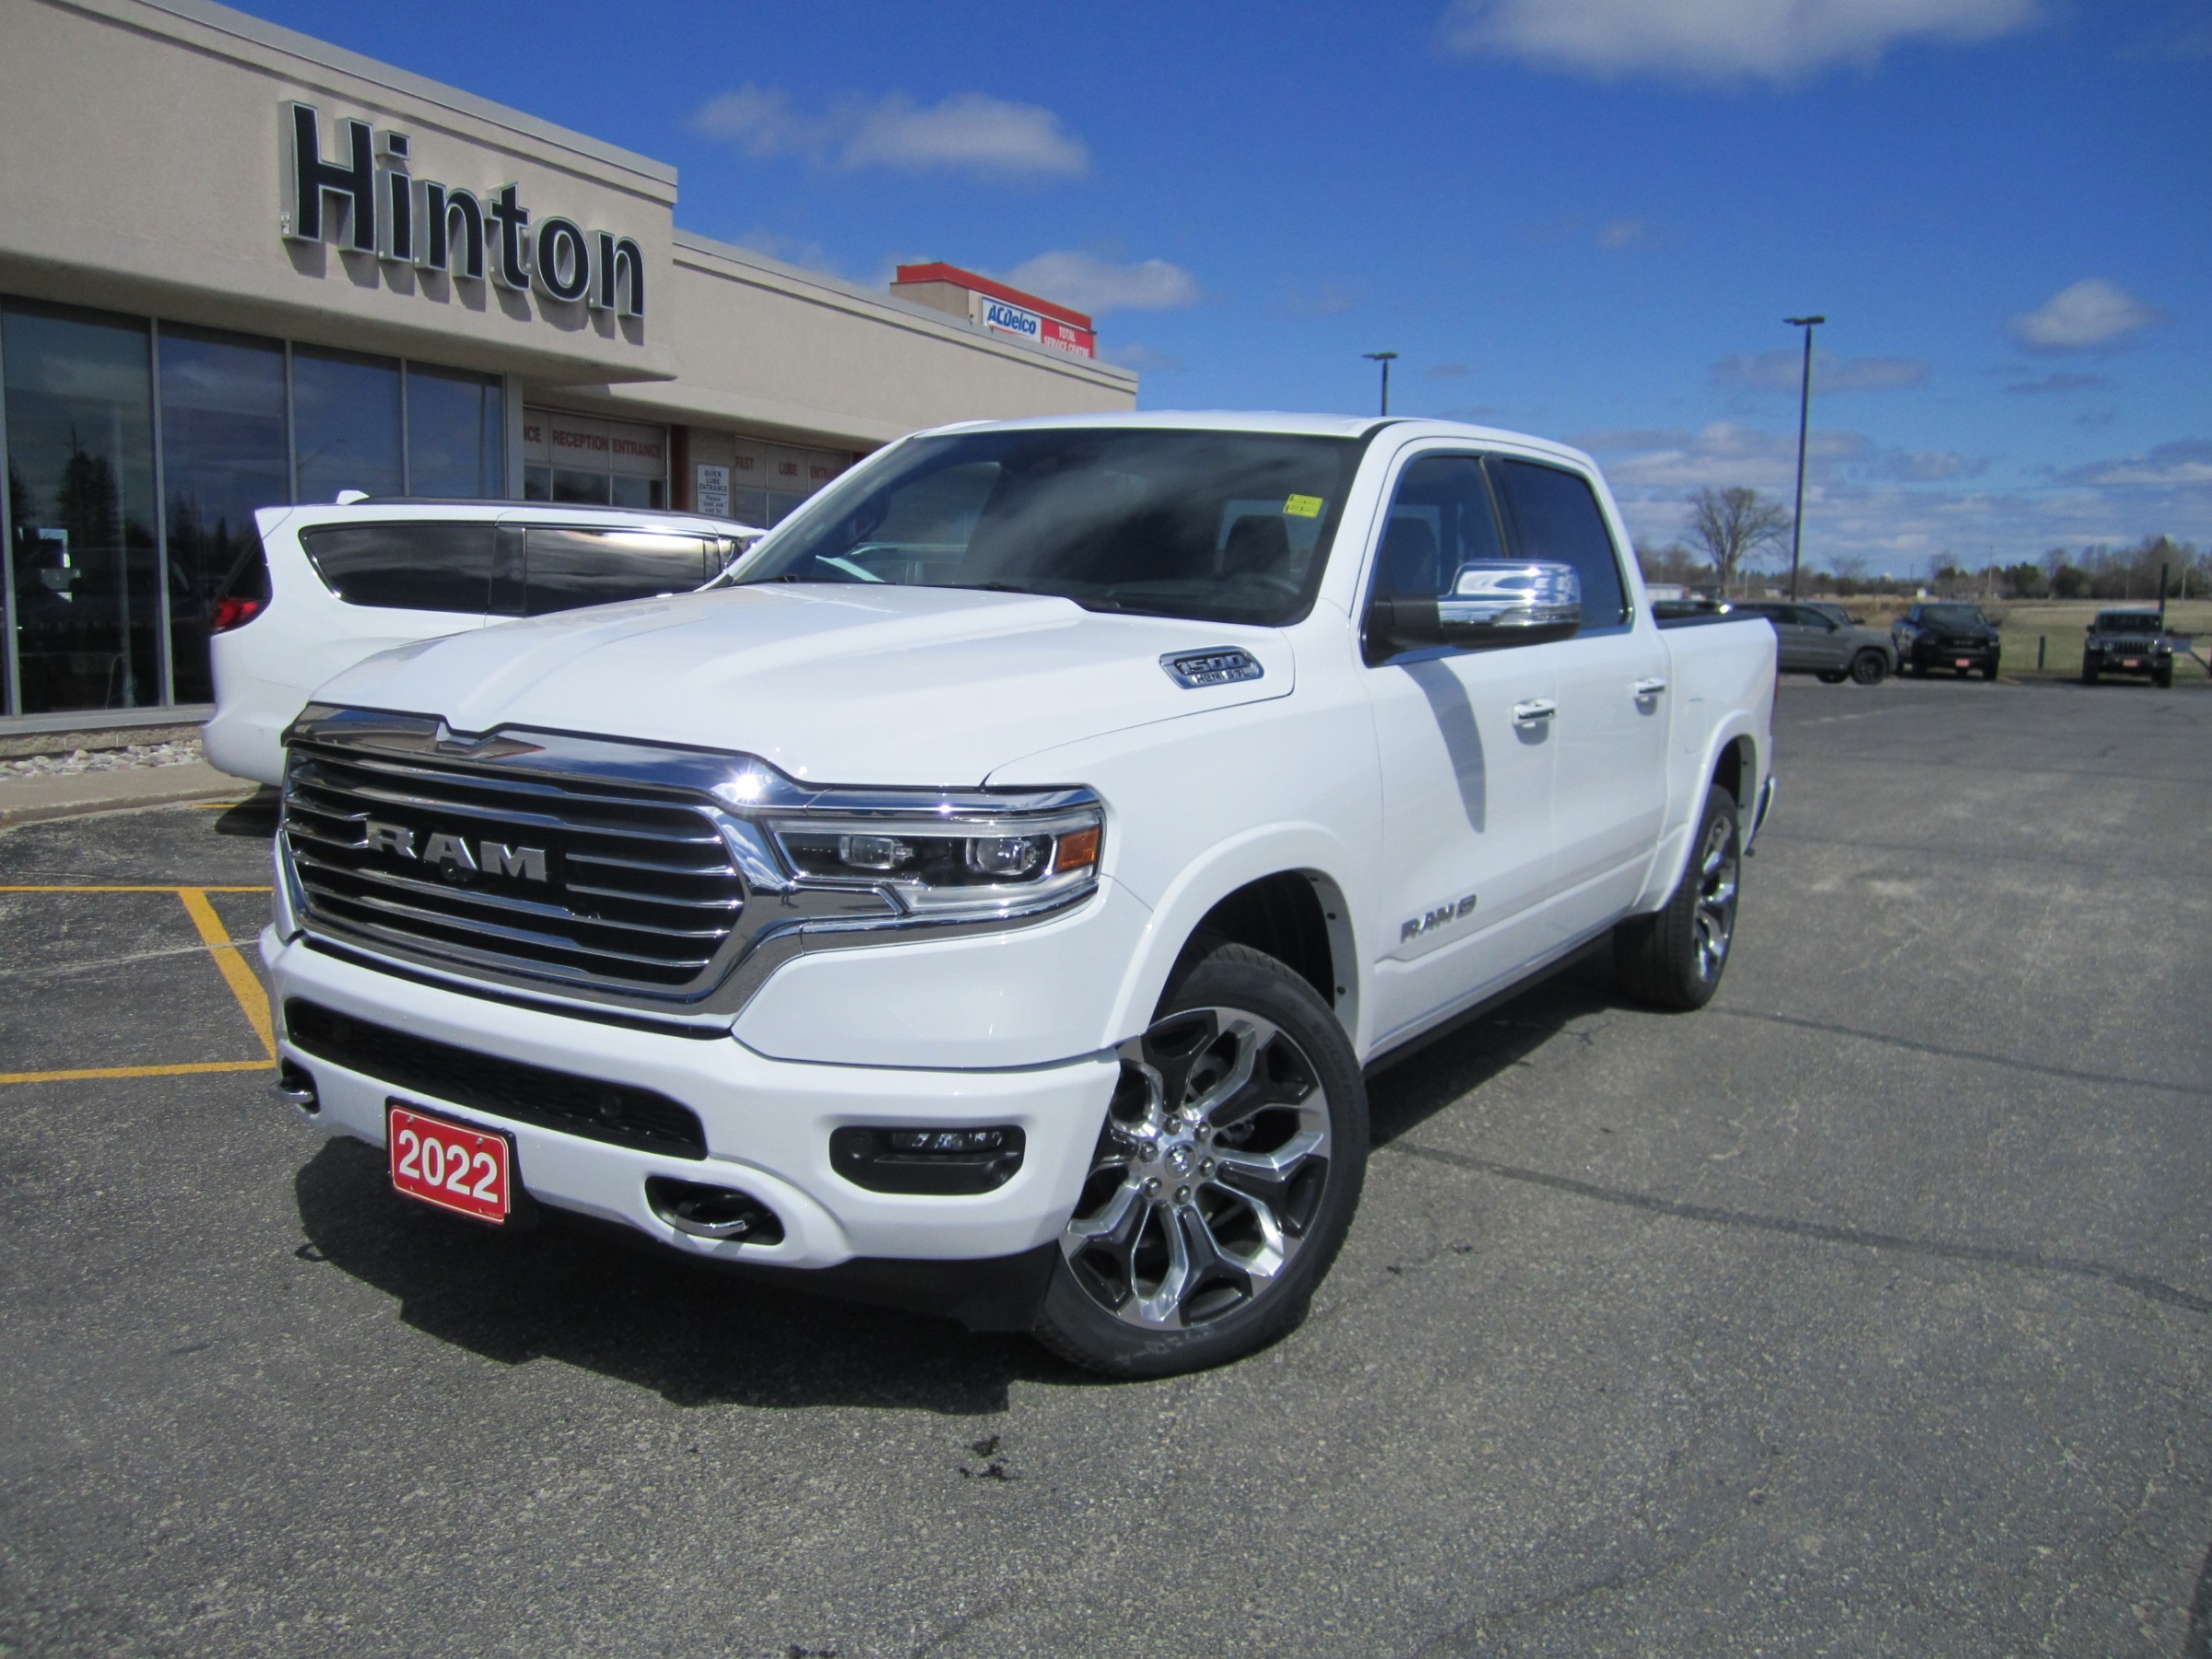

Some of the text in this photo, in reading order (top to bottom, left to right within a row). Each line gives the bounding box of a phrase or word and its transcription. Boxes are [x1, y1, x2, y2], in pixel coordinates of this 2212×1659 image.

[281, 100, 644, 318] Hinton
[987, 304, 1037, 335] ACDelco
[1058, 325, 1077, 343] TOTAL
[1043, 335, 1090, 358] SERVICE CENTRE
[524, 426, 663, 459] ICE RECEPTION ENTRANCE
[704, 469, 722, 477] QUICK
[736, 455, 754, 471] FAST
[779, 462, 798, 476] LUBE
[699, 483, 728, 492] ENTRANCE
[706, 477, 721, 485] LUBE
[1177, 654, 1246, 676] 1500
[1196, 670, 1227, 683] HEMI
[366, 819, 547, 883] RAM
[1400, 902, 1454, 944] RAM
[398, 1129, 499, 1204] 2022
